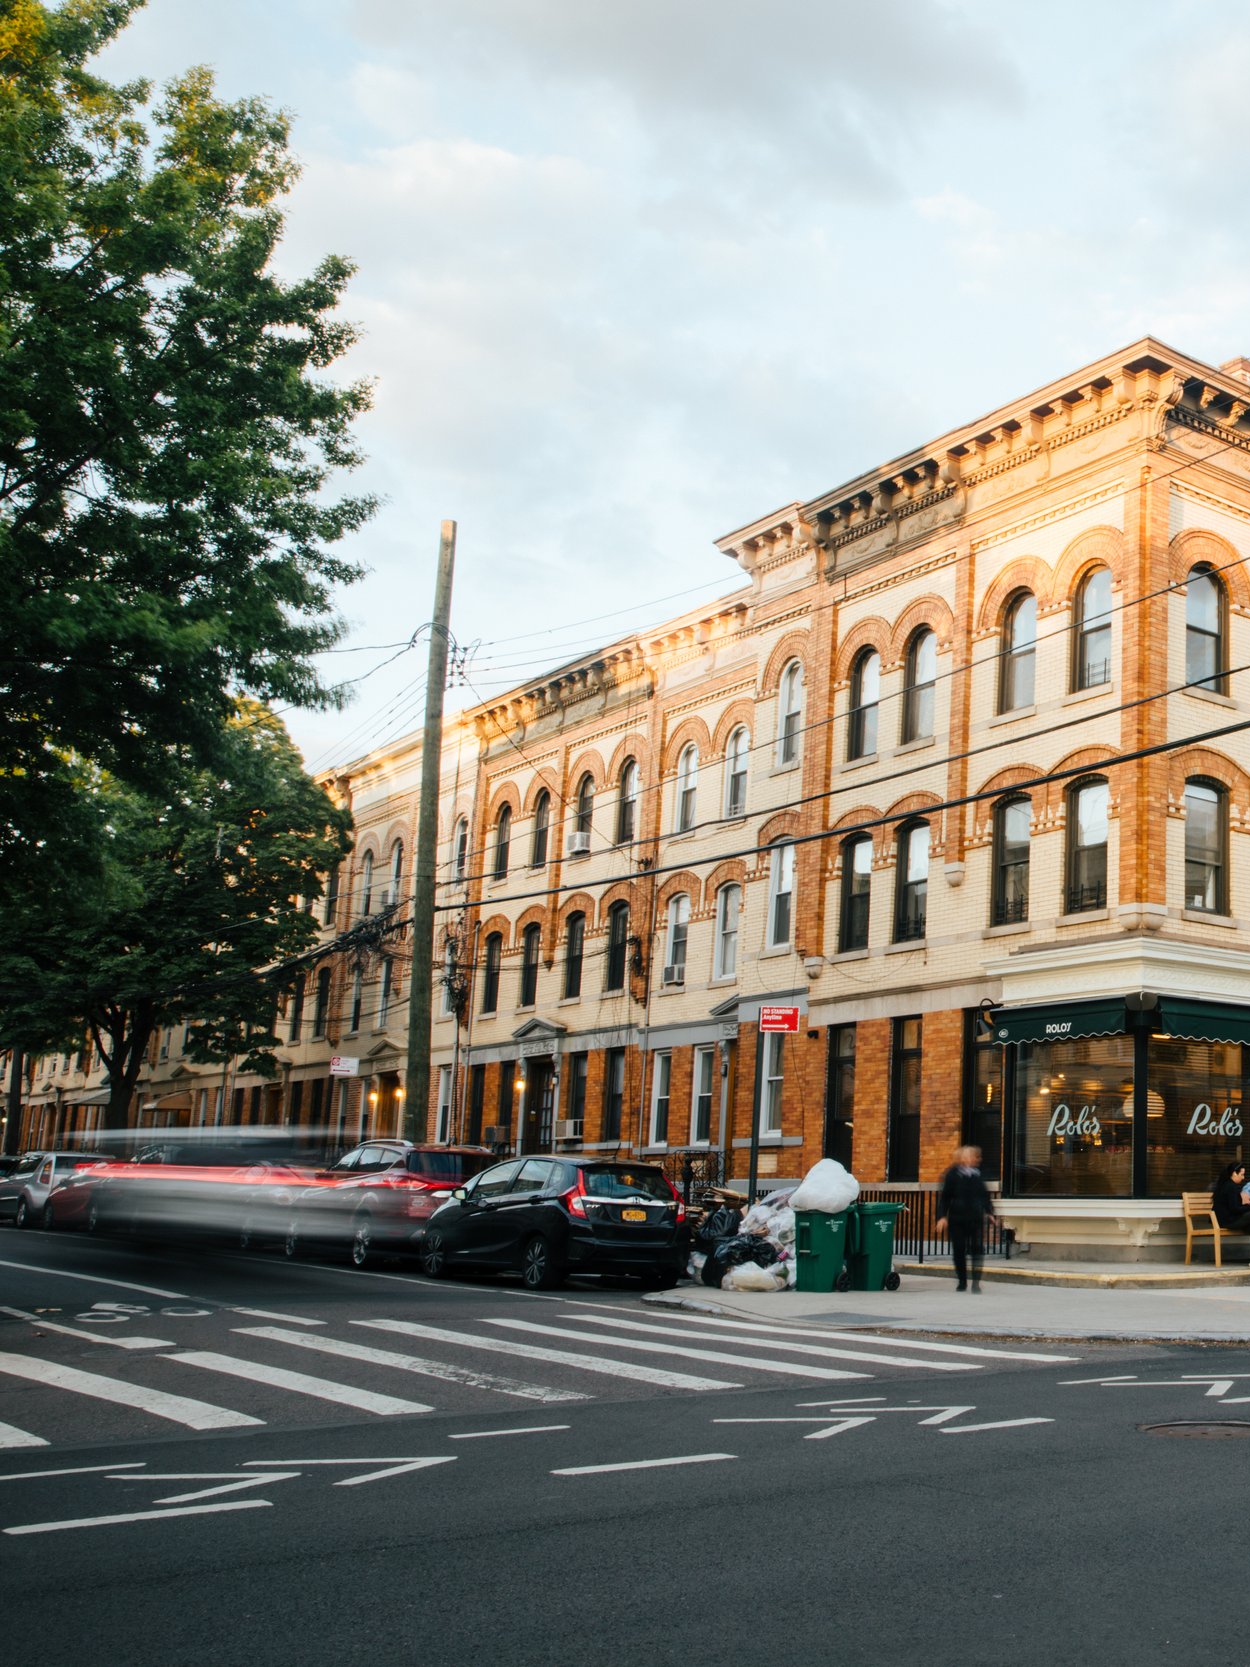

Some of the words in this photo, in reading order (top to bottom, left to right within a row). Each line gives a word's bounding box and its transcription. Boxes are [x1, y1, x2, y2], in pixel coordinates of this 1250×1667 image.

[1046, 1022, 1072, 1033] ROLO'S
[1046, 1103, 1100, 1136] Rolo's
[1186, 1103, 1243, 1137] Rolo's
